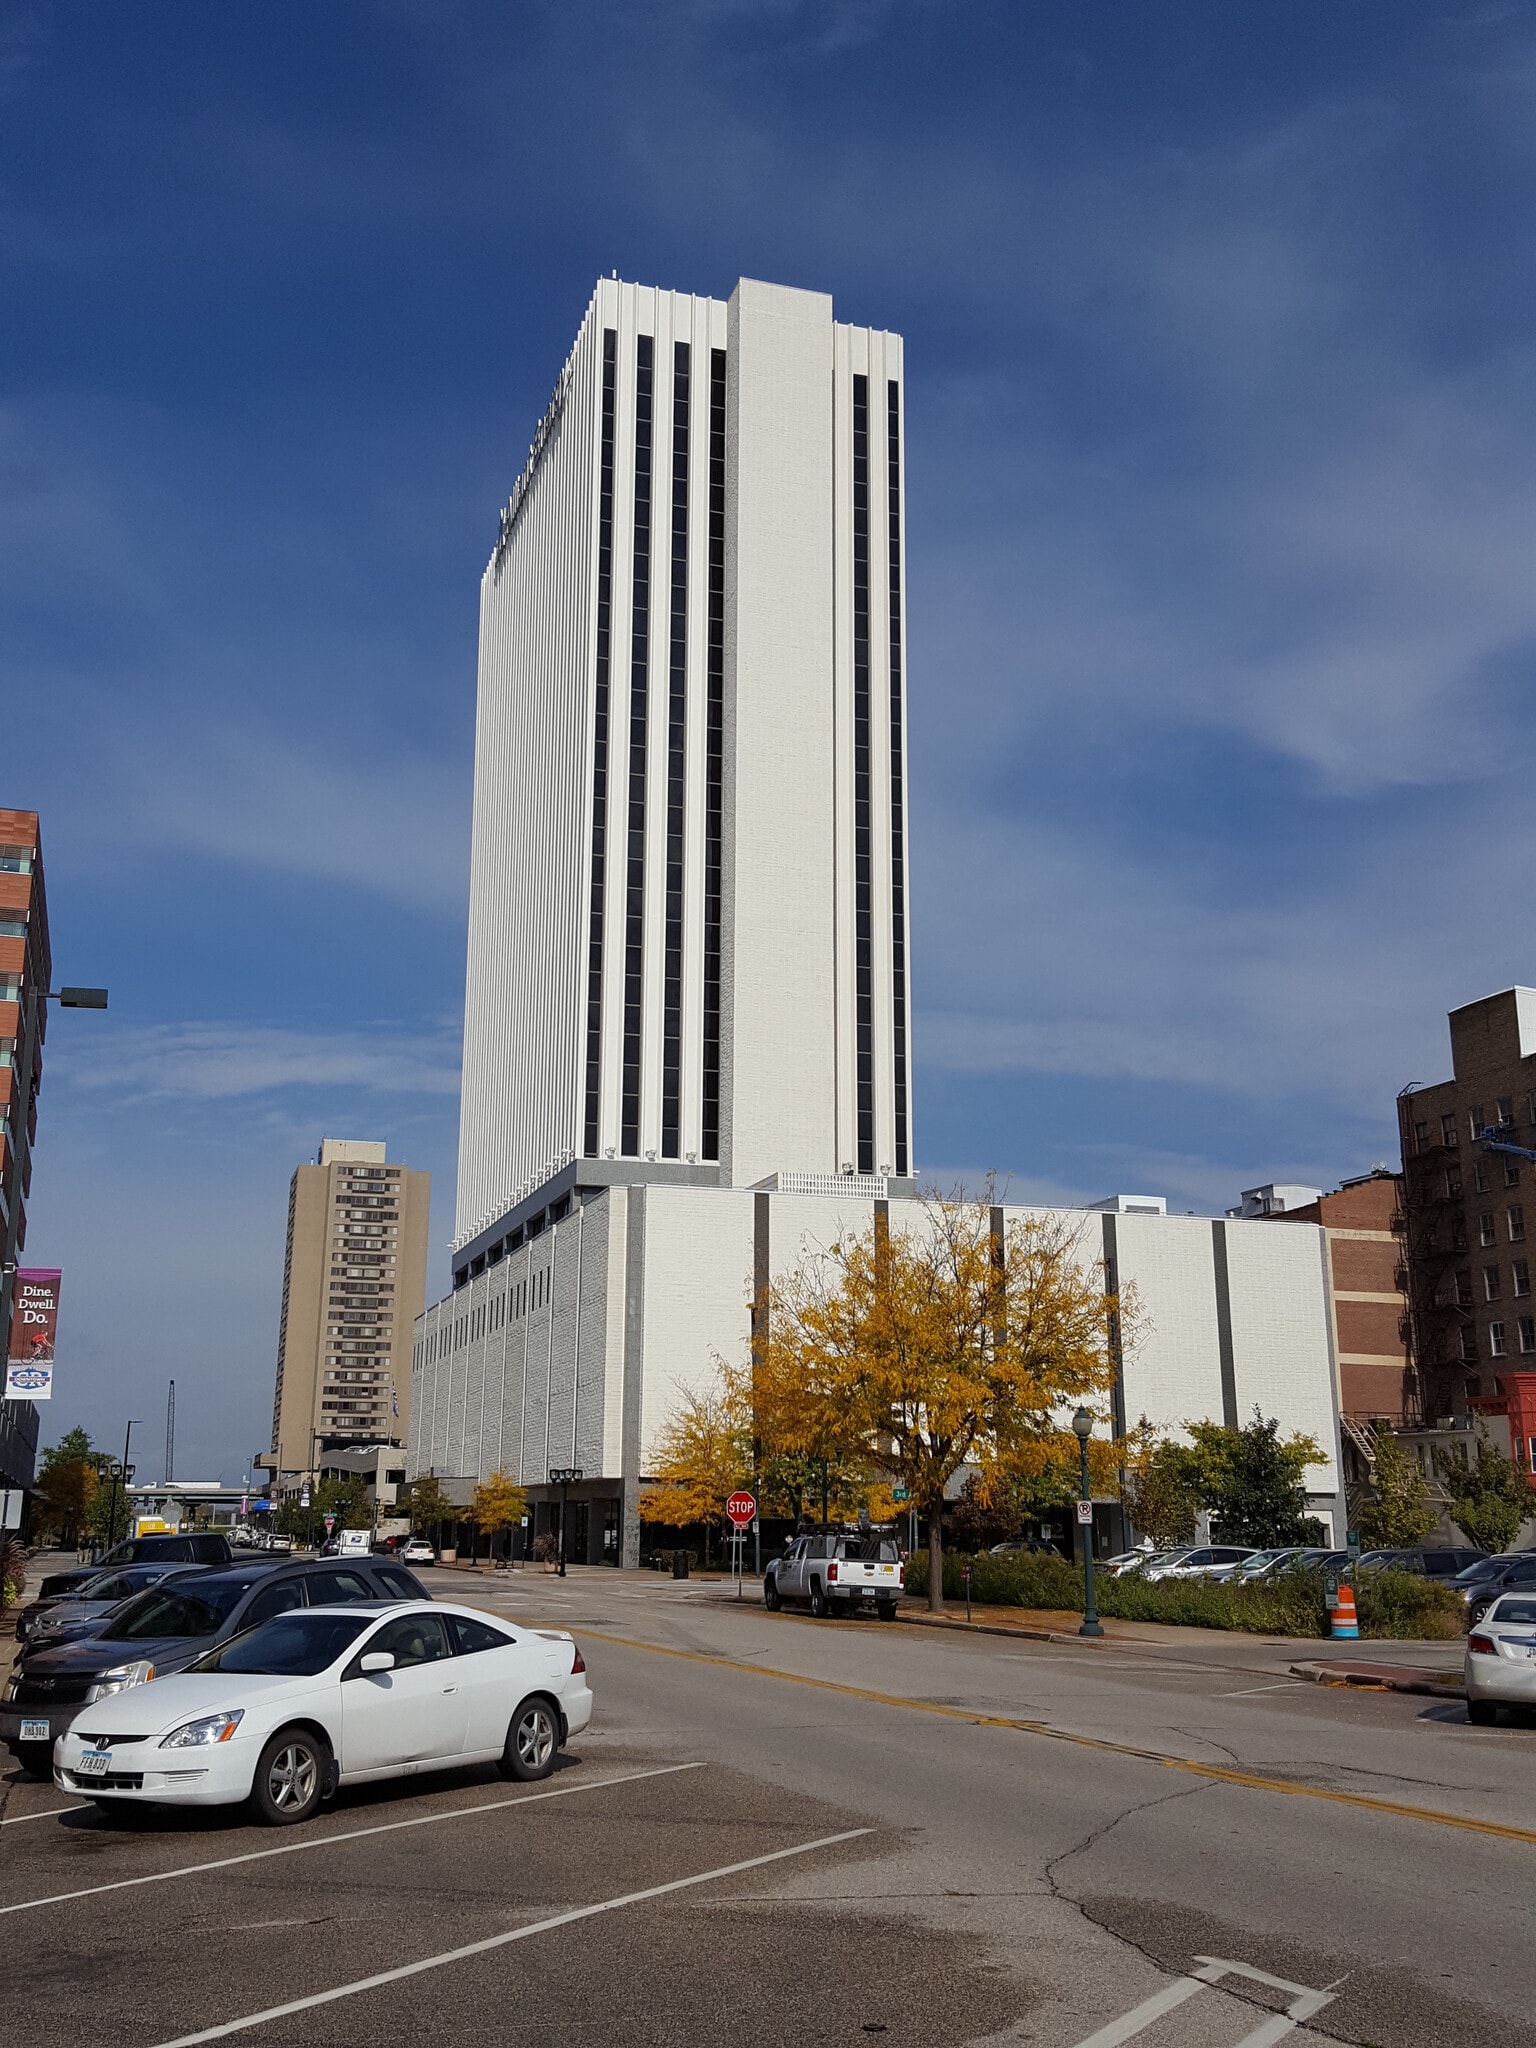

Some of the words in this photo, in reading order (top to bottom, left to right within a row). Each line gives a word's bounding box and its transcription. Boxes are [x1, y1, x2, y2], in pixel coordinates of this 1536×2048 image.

[23, 1286, 53, 1297] Dine.
[18, 1298, 56, 1310] Dwell.
[22, 1310, 48, 1324] Do.
[728, 1501, 754, 1513] STOP
